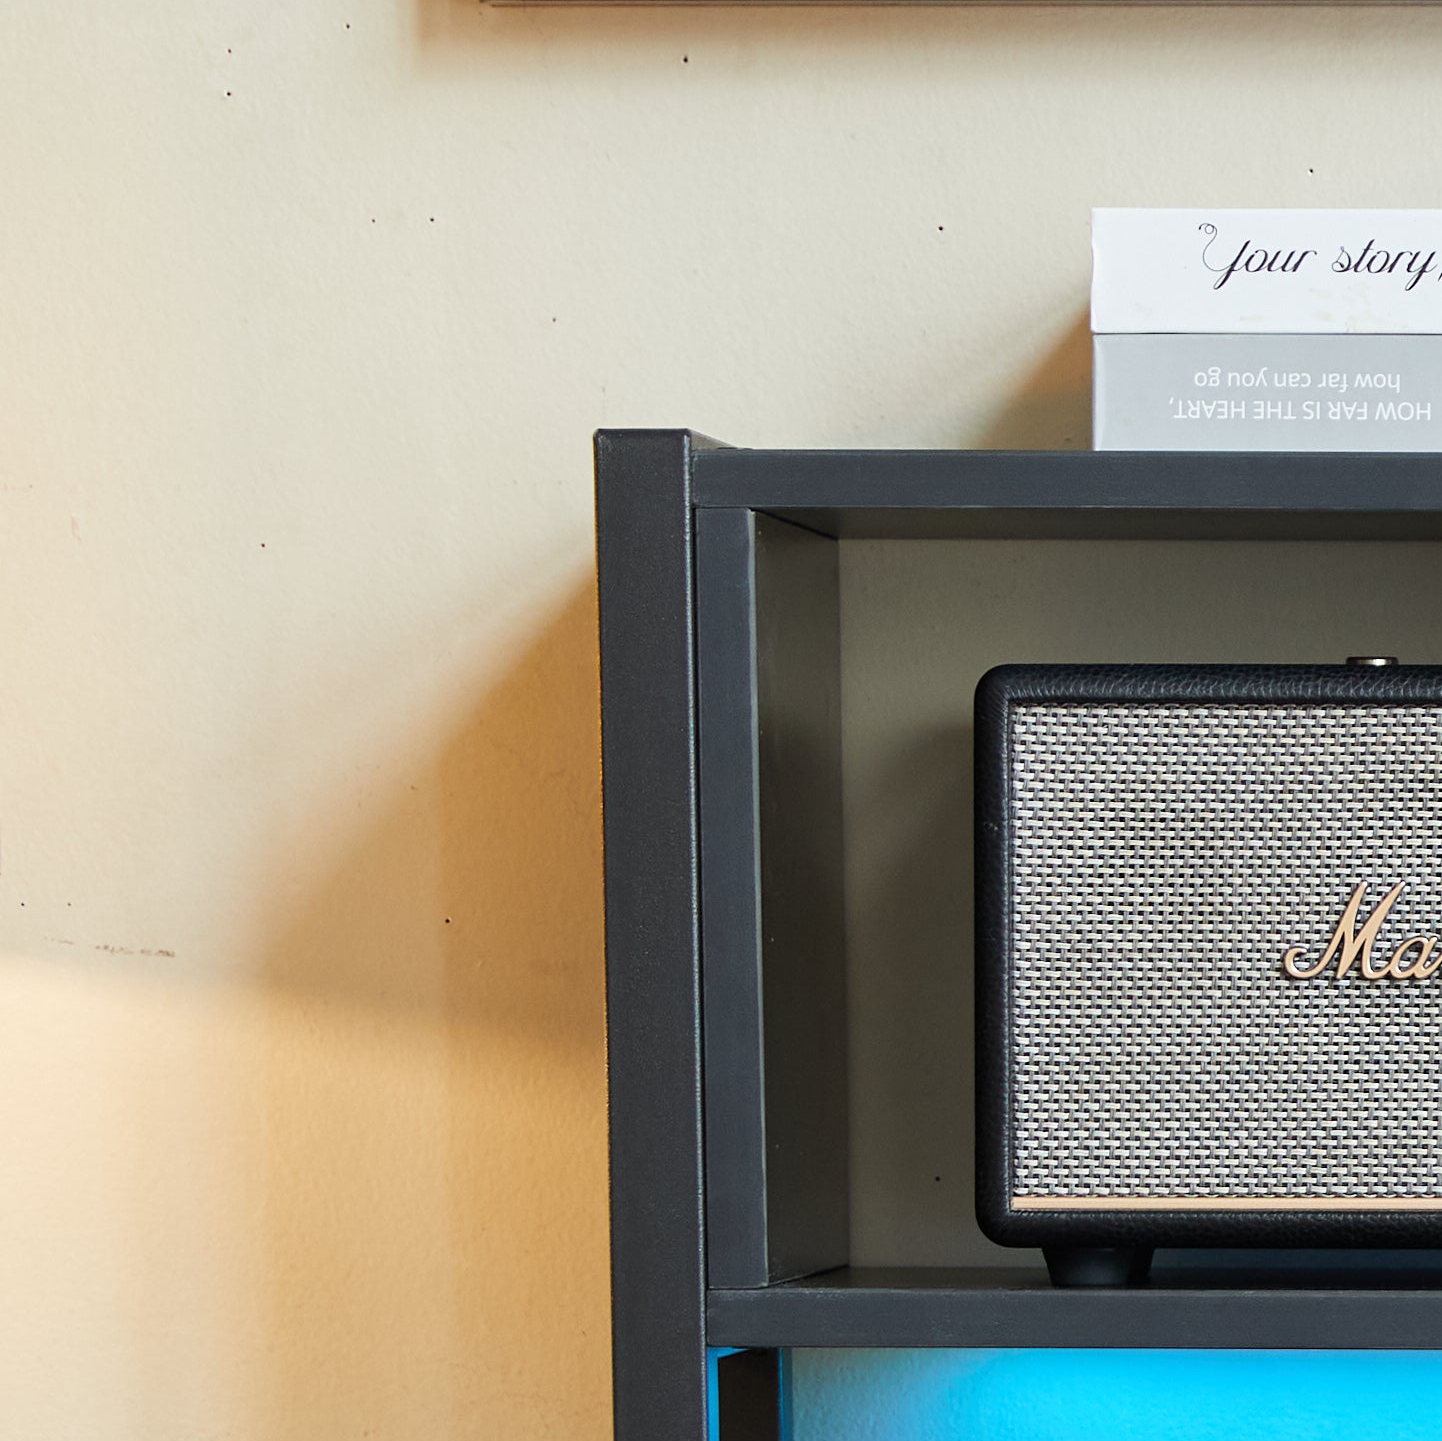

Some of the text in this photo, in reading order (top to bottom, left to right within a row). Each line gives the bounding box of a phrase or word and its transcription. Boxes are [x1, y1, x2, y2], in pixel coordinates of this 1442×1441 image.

[1198, 222, 1317, 290] Your
[1194, 369, 1402, 394] how far can you go
[1169, 396, 1431, 422] HOW FAR IS THE HEART,
